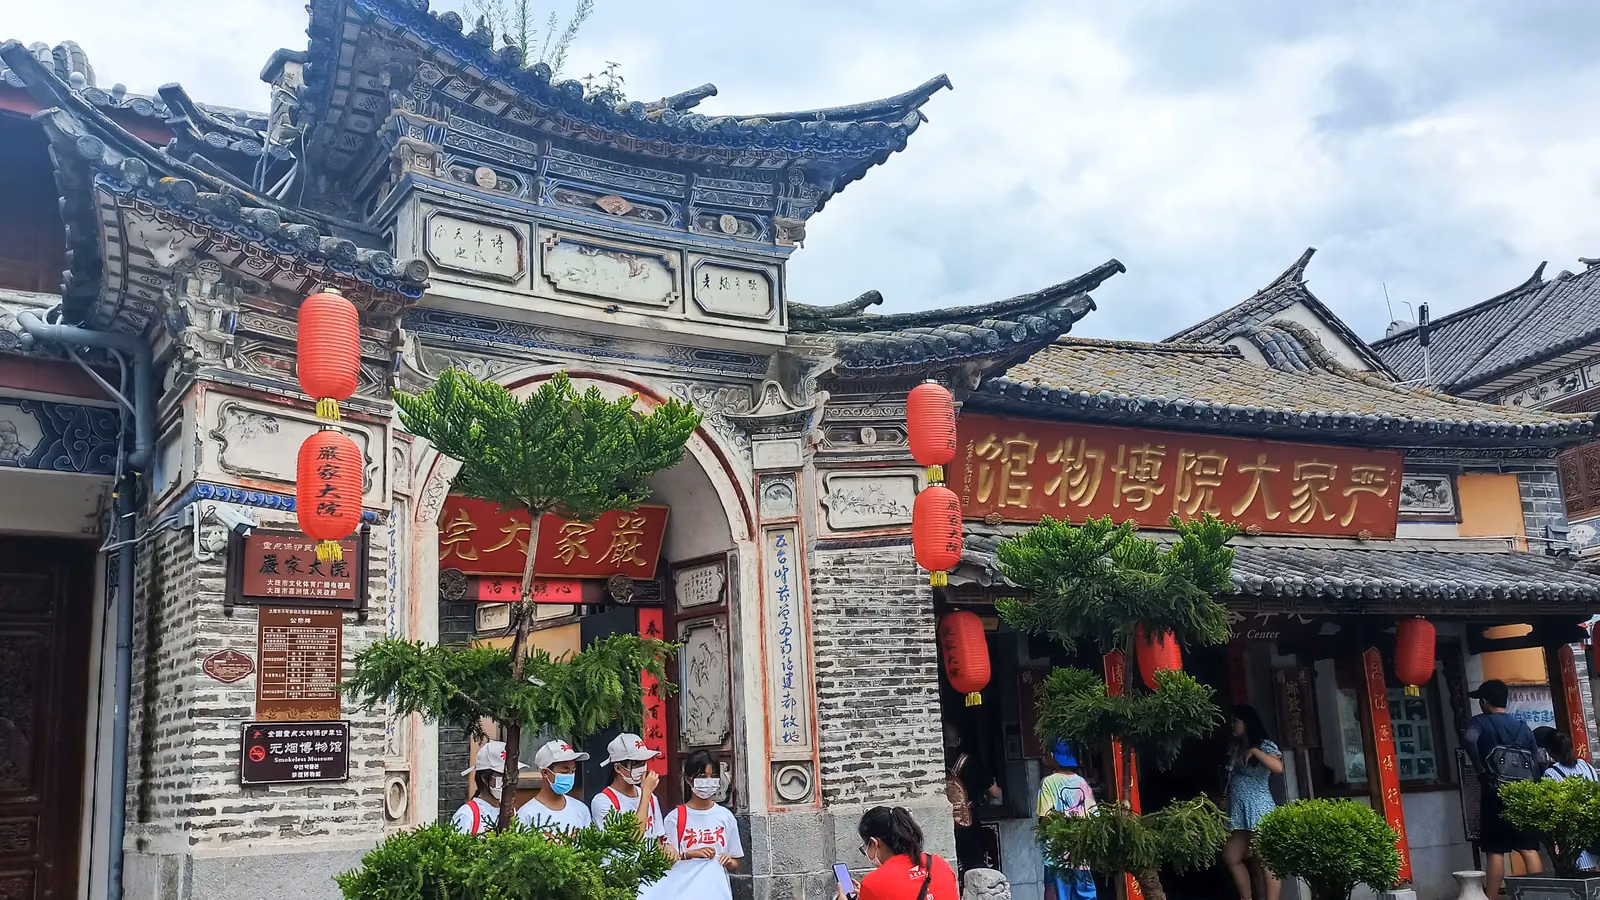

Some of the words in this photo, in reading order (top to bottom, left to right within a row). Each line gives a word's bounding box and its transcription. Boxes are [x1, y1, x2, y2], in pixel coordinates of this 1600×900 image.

[976, 433, 1389, 528] 严家大院博物馆
[263, 541, 354, 552] 重点保护民一
[1246, 629, 1280, 639] Center
[269, 741, 343, 754] 无烟博物馆
[684, 826, 725, 848] 去远方
